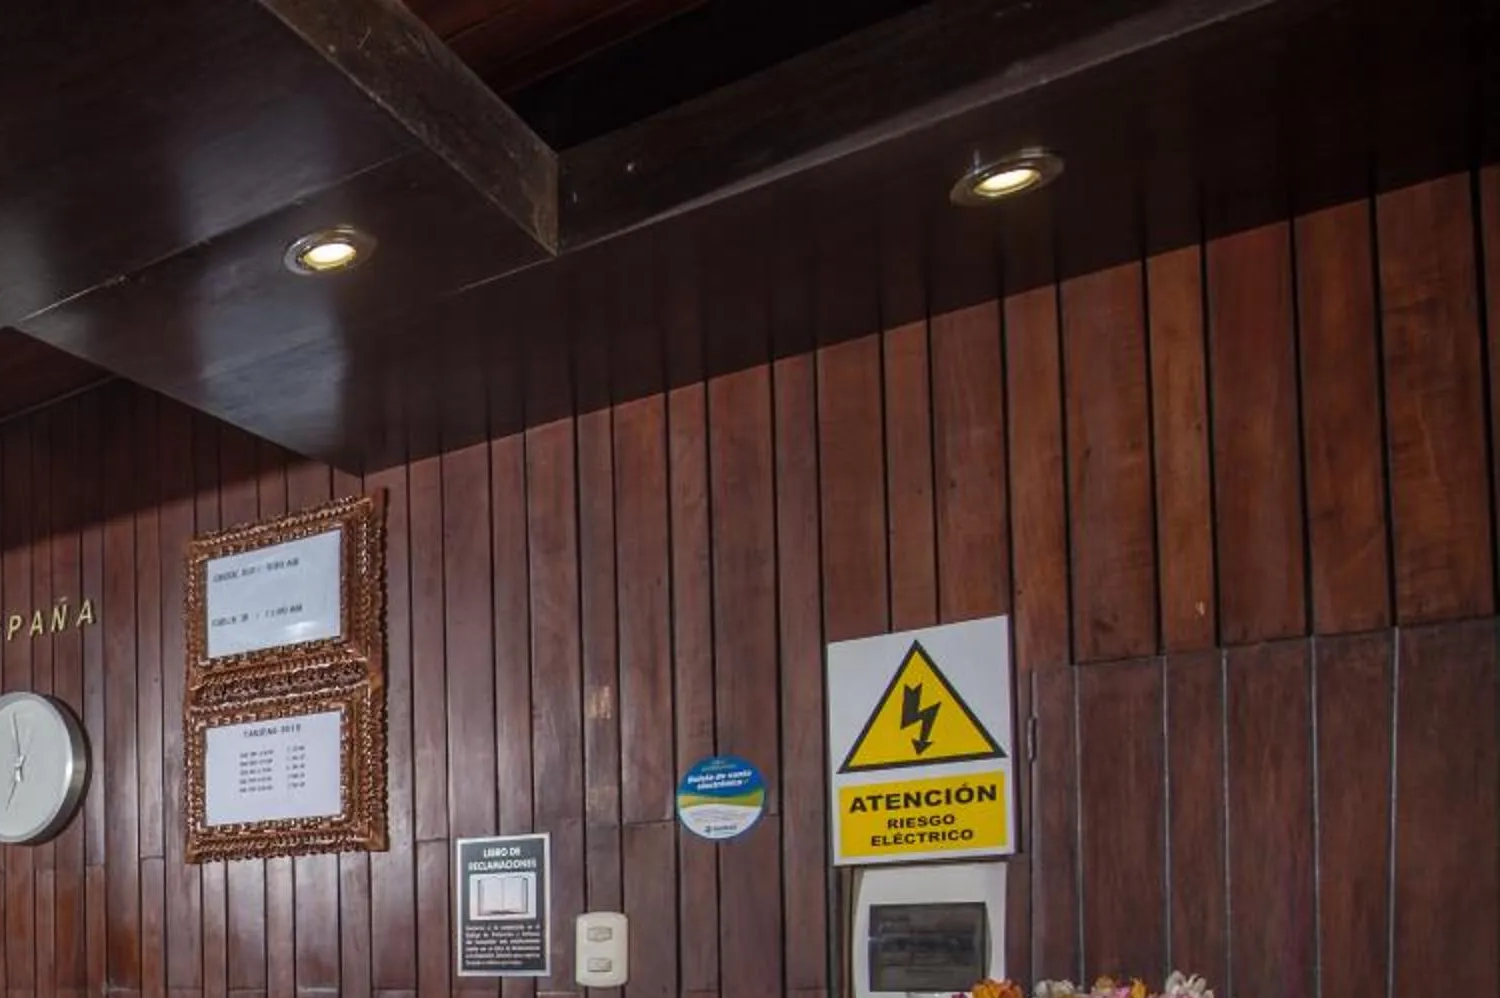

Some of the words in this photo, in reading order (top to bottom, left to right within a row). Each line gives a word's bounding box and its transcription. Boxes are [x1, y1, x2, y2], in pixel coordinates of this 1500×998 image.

[850, 782, 997, 813] ATENCIÓN
[887, 813, 956, 829] RIESGO
[871, 828, 974, 847] ELÉCTRICO
[483, 847, 508, 859] LIBRO
